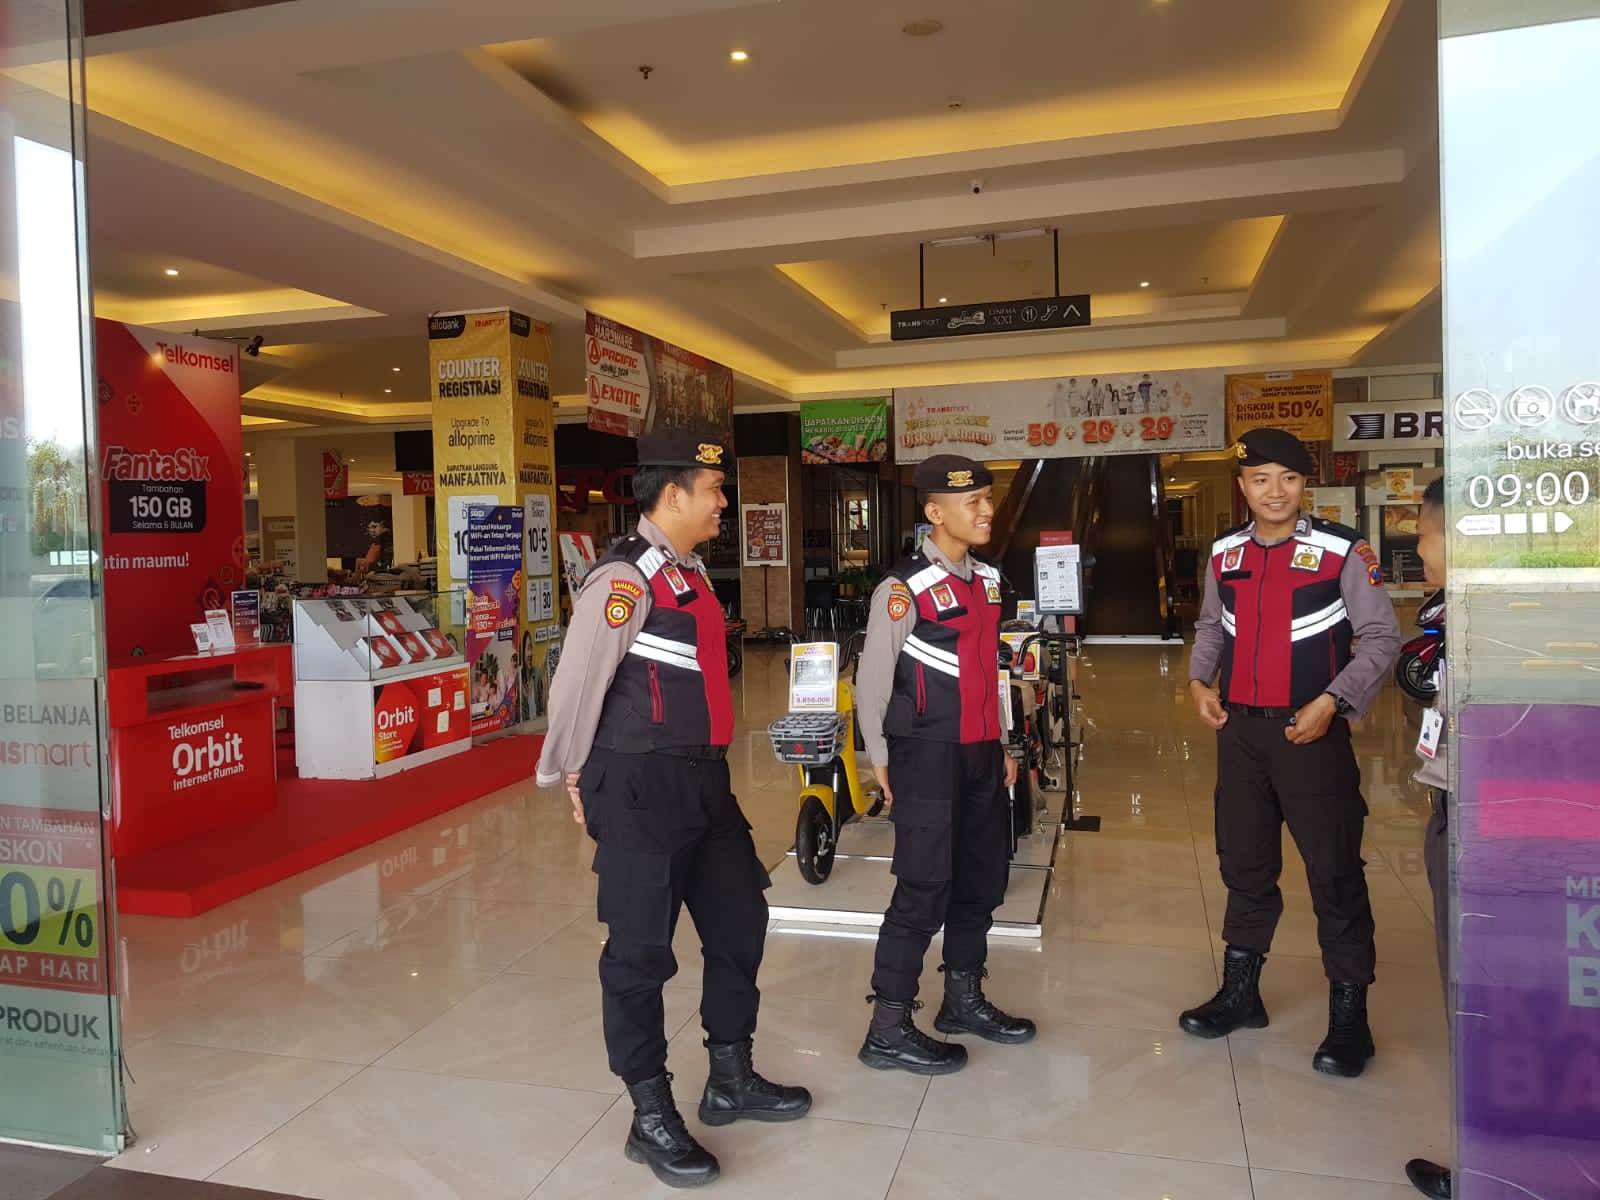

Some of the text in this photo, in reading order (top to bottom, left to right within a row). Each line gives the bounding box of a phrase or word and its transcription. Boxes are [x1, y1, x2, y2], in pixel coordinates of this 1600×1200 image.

[156, 341, 234, 373] Telkomsel
[438, 357, 501, 379] COUNTER
[602, 346, 638, 369] PACIFIC
[439, 380, 501, 398] REGISTRASI
[602, 383, 640, 408] EXOTIC
[1236, 402, 1275, 413] DISKON
[1236, 412, 1275, 422] HINGGA
[1278, 400, 1324, 418] 50%
[481, 416, 489, 427] To
[448, 429, 495, 451] alloprime
[1506, 440, 1572, 460] buka
[102, 446, 212, 482] FantaSix
[141, 483, 184, 494] Tambahan
[439, 471, 506, 487] MANFAATNYA
[1469, 471, 1590, 509] 09:00
[129, 496, 192, 518] 150 GB
[132, 519, 163, 530] Selama
[170, 519, 193, 530] BULAN
[132, 551, 190, 569] maumu!
[4, 703, 92, 727] BELANJA
[377, 705, 415, 730] Orbit
[168, 714, 225, 741] Telkomsel
[378, 730, 398, 742] Store
[172, 731, 244, 776] Orbit
[172, 762, 245, 792] Internet Rumah
[14, 816, 96, 834] TAMBAHAN
[0, 838, 64, 865] SKON
[40, 959, 98, 983] HARI
